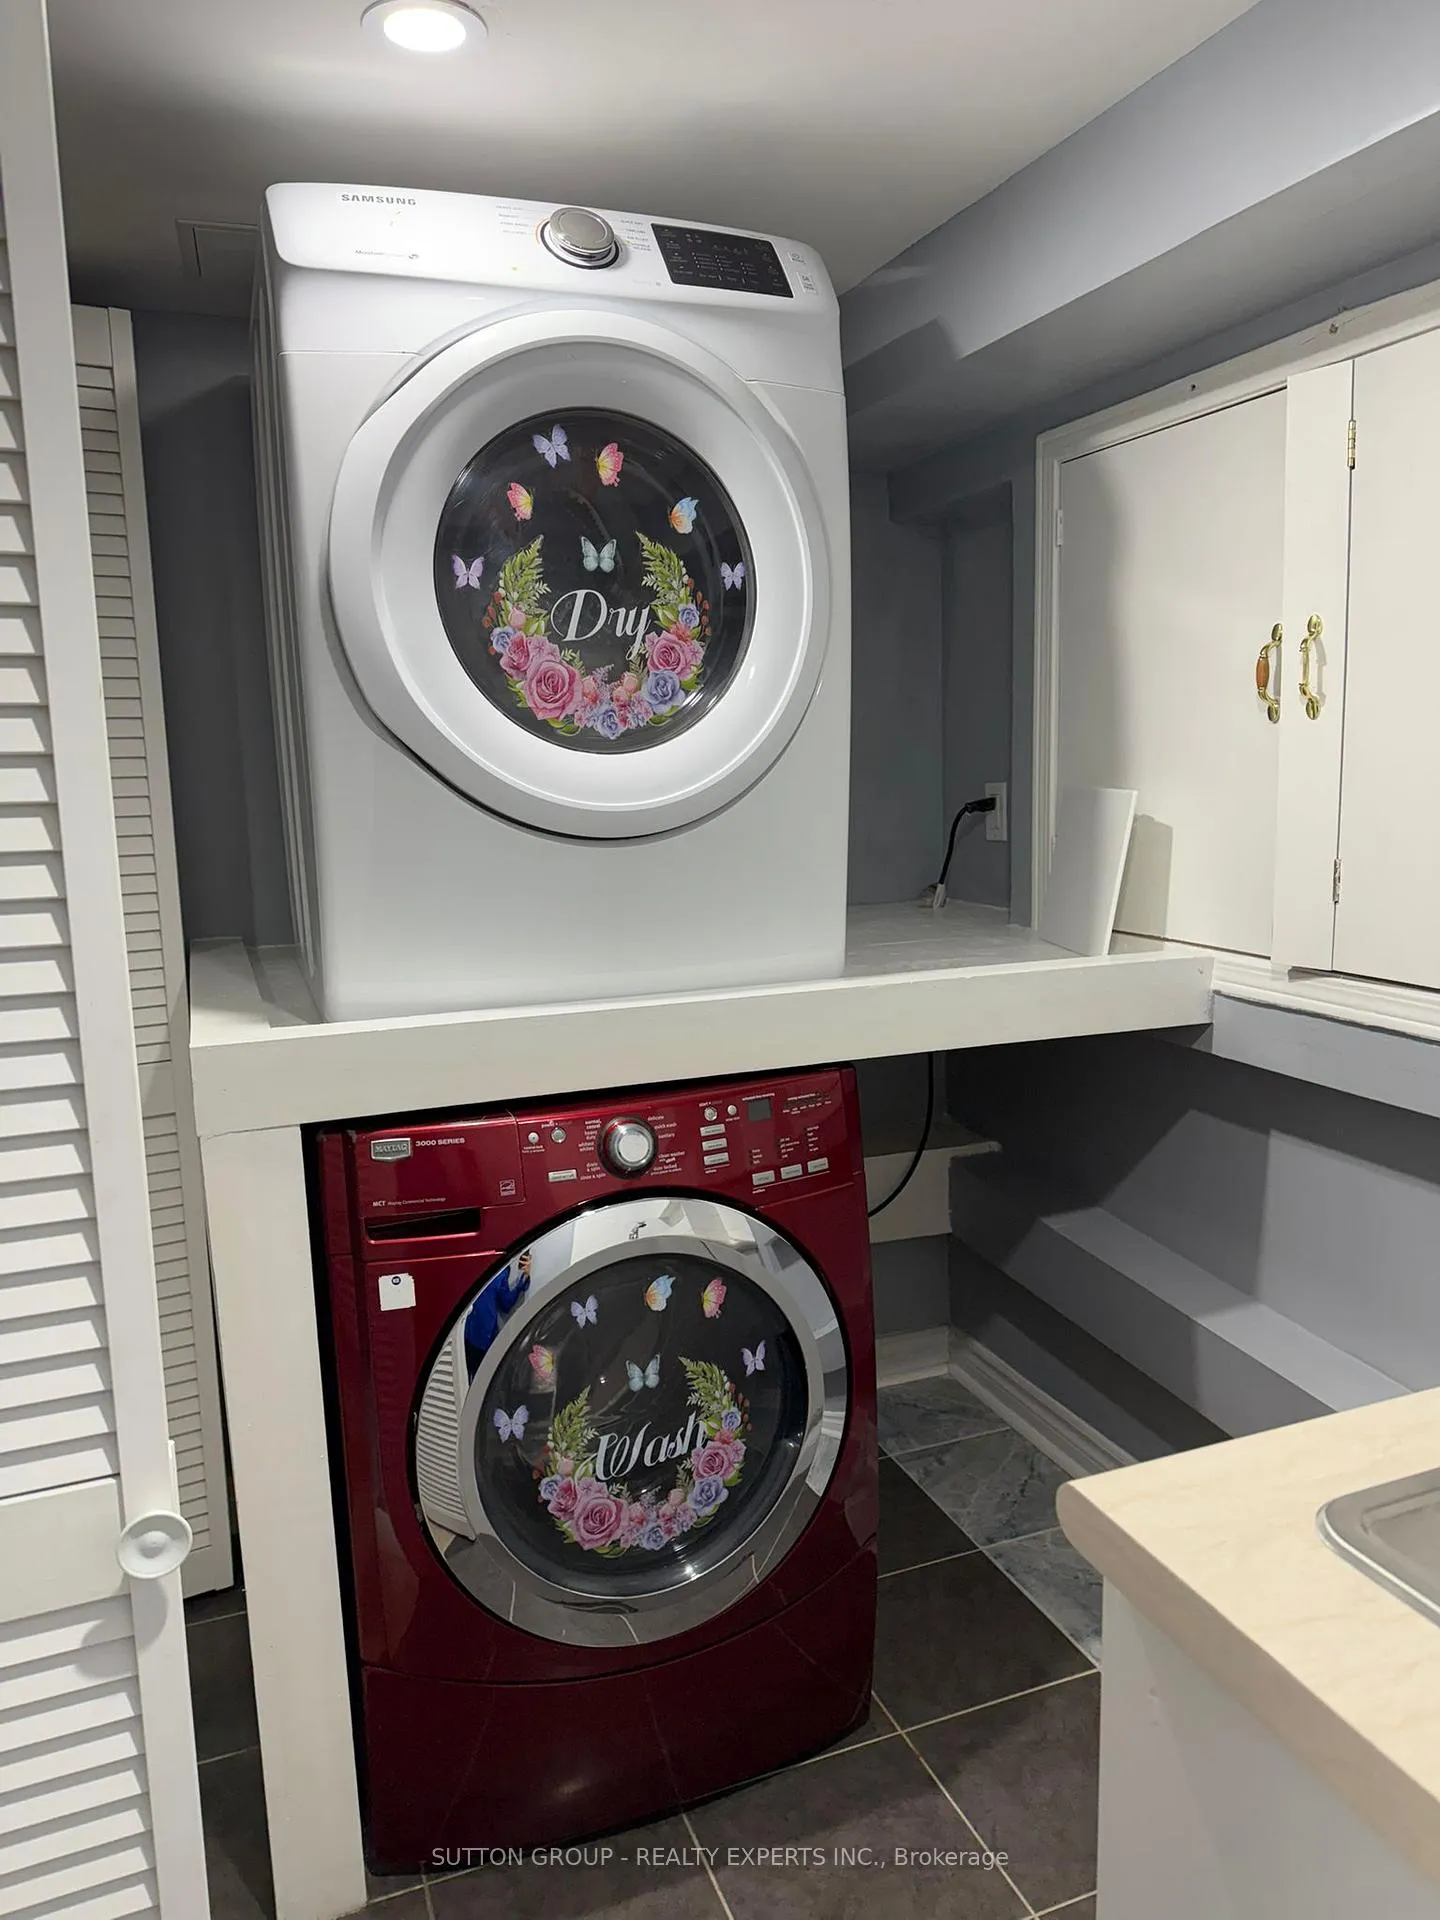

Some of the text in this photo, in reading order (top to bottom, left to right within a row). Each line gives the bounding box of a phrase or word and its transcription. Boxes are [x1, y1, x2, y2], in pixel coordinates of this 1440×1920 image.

[341, 193, 417, 206] SAMSUNG
[550, 588, 652, 661] Dry
[415, 1137, 465, 1147] 3000 SERIES
[584, 1410, 708, 1483] Wash
